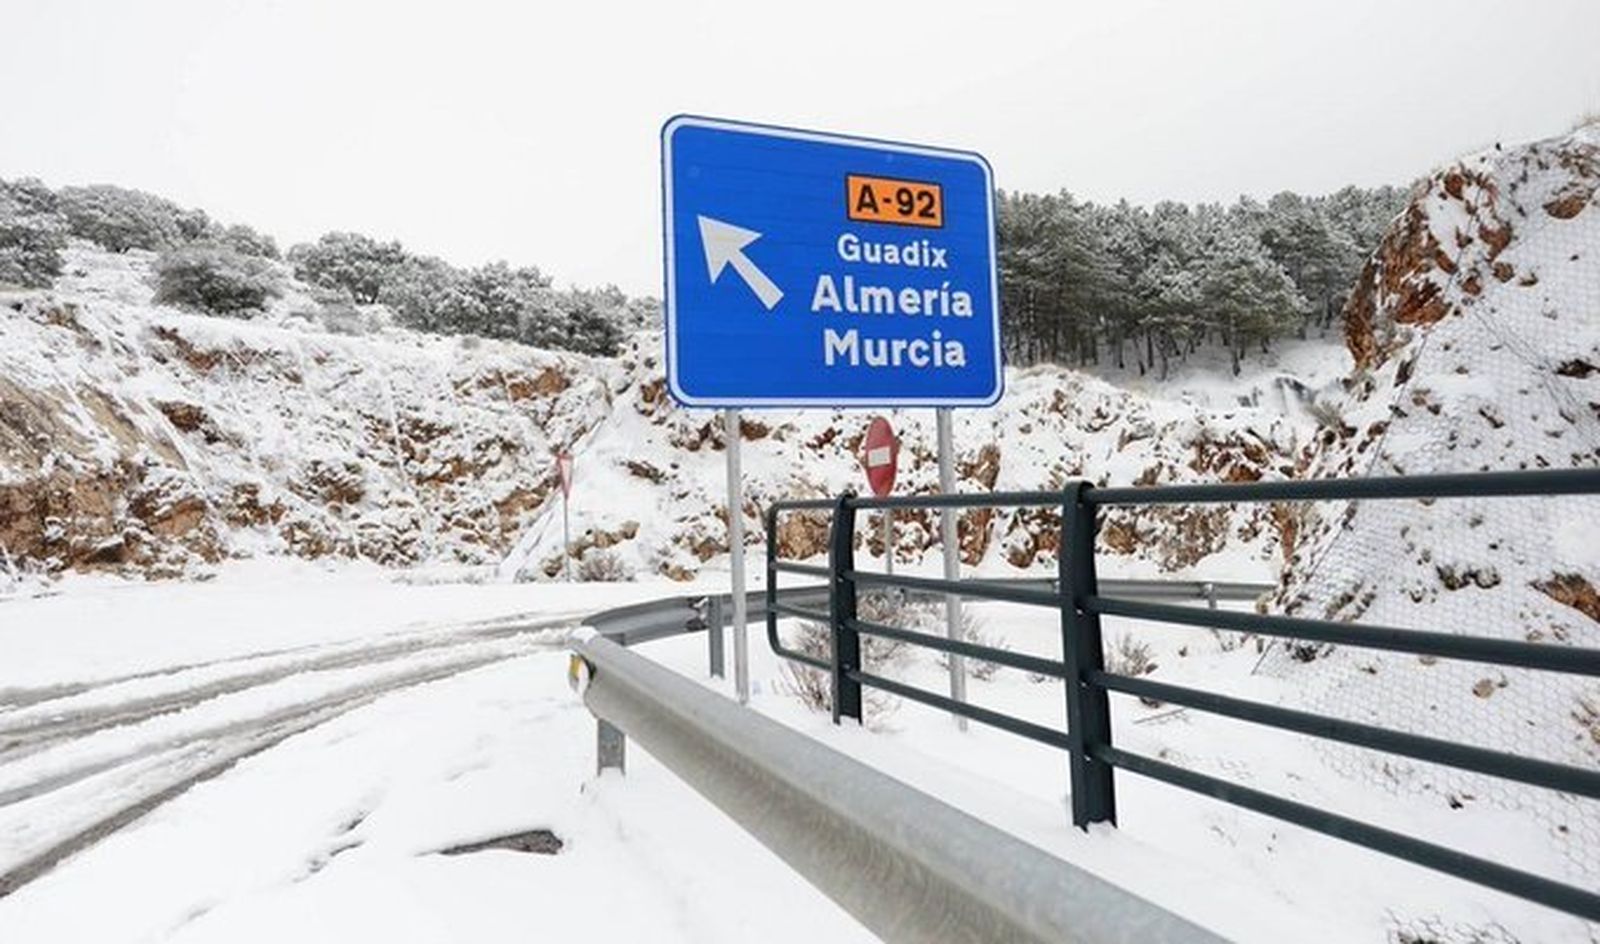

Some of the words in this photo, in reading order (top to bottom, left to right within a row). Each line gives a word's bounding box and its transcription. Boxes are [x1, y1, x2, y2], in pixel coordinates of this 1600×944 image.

[856, 185, 936, 219] A-92
[837, 233, 948, 268] Guadix
[811, 275, 973, 317] Almería
[824, 328, 966, 367] Murcia
